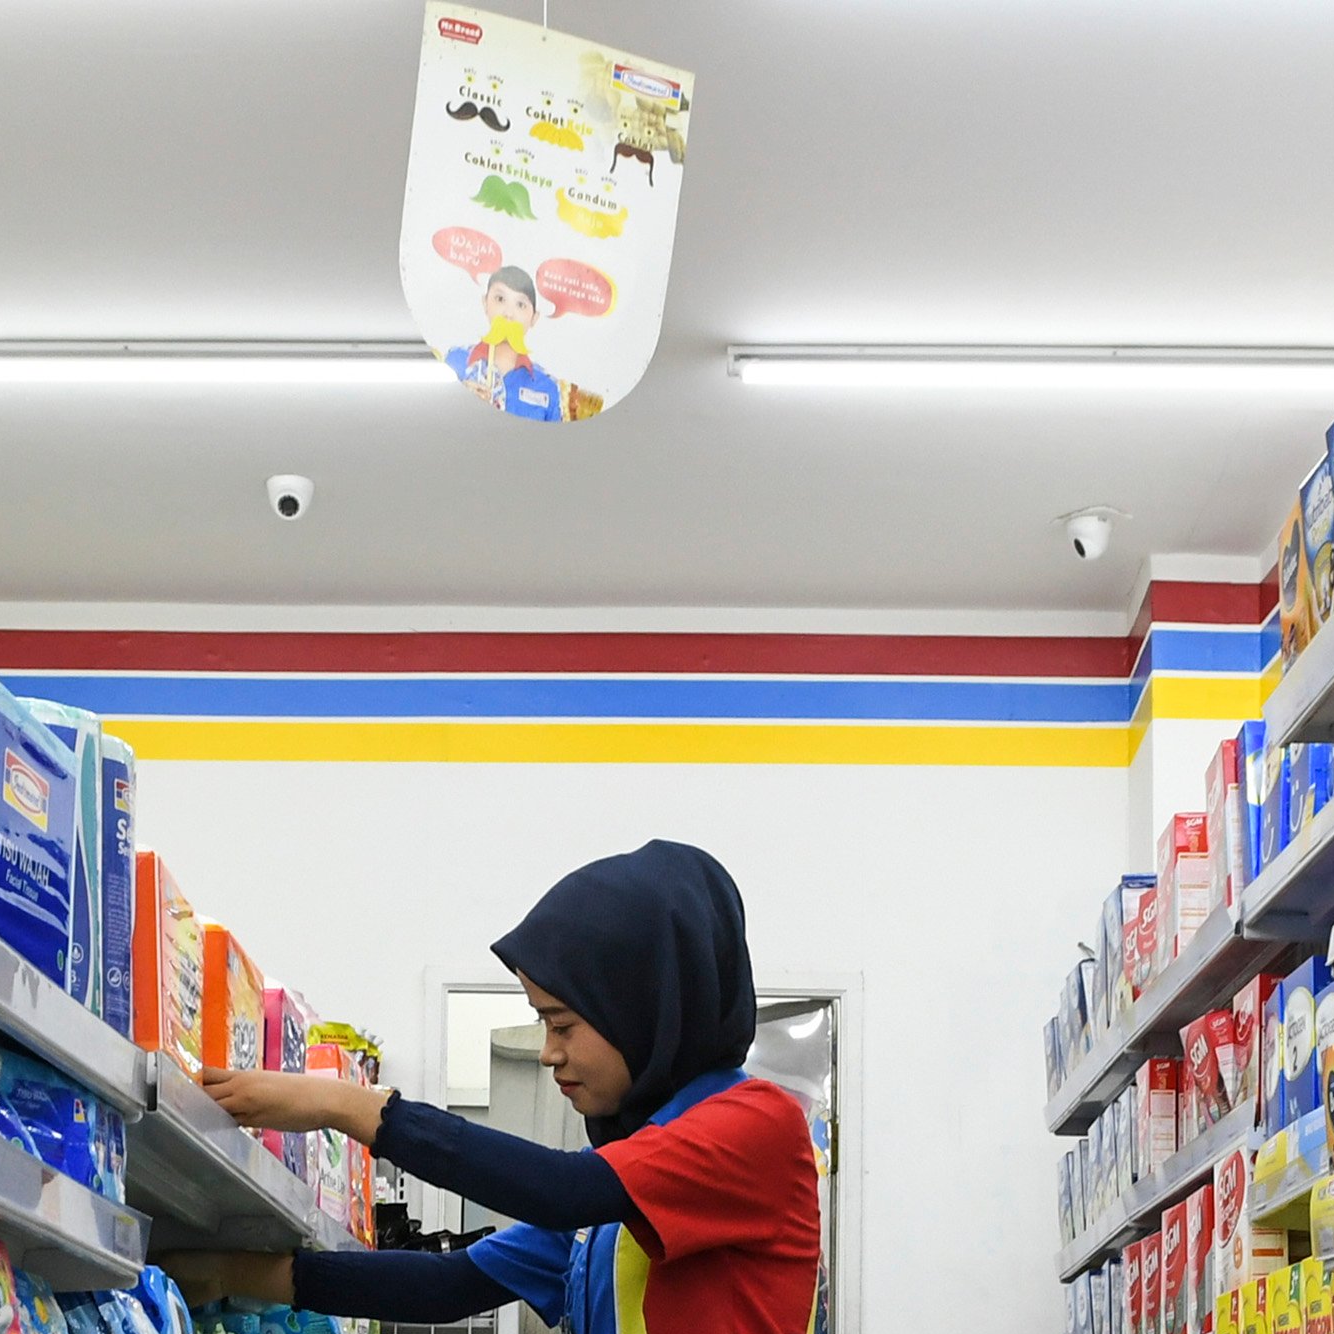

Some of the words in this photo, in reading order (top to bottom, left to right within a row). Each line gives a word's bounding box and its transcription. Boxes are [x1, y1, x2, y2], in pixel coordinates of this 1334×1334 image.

[458, 86, 503, 107] Classic
[525, 106, 564, 128] Coklat
[464, 152, 503, 173] Coklat
[505, 164, 553, 188] Srikaya
[568, 187, 618, 211] Gandum
[19, 849, 51, 887] WAJAH
[1190, 1036, 1209, 1069] SGM
